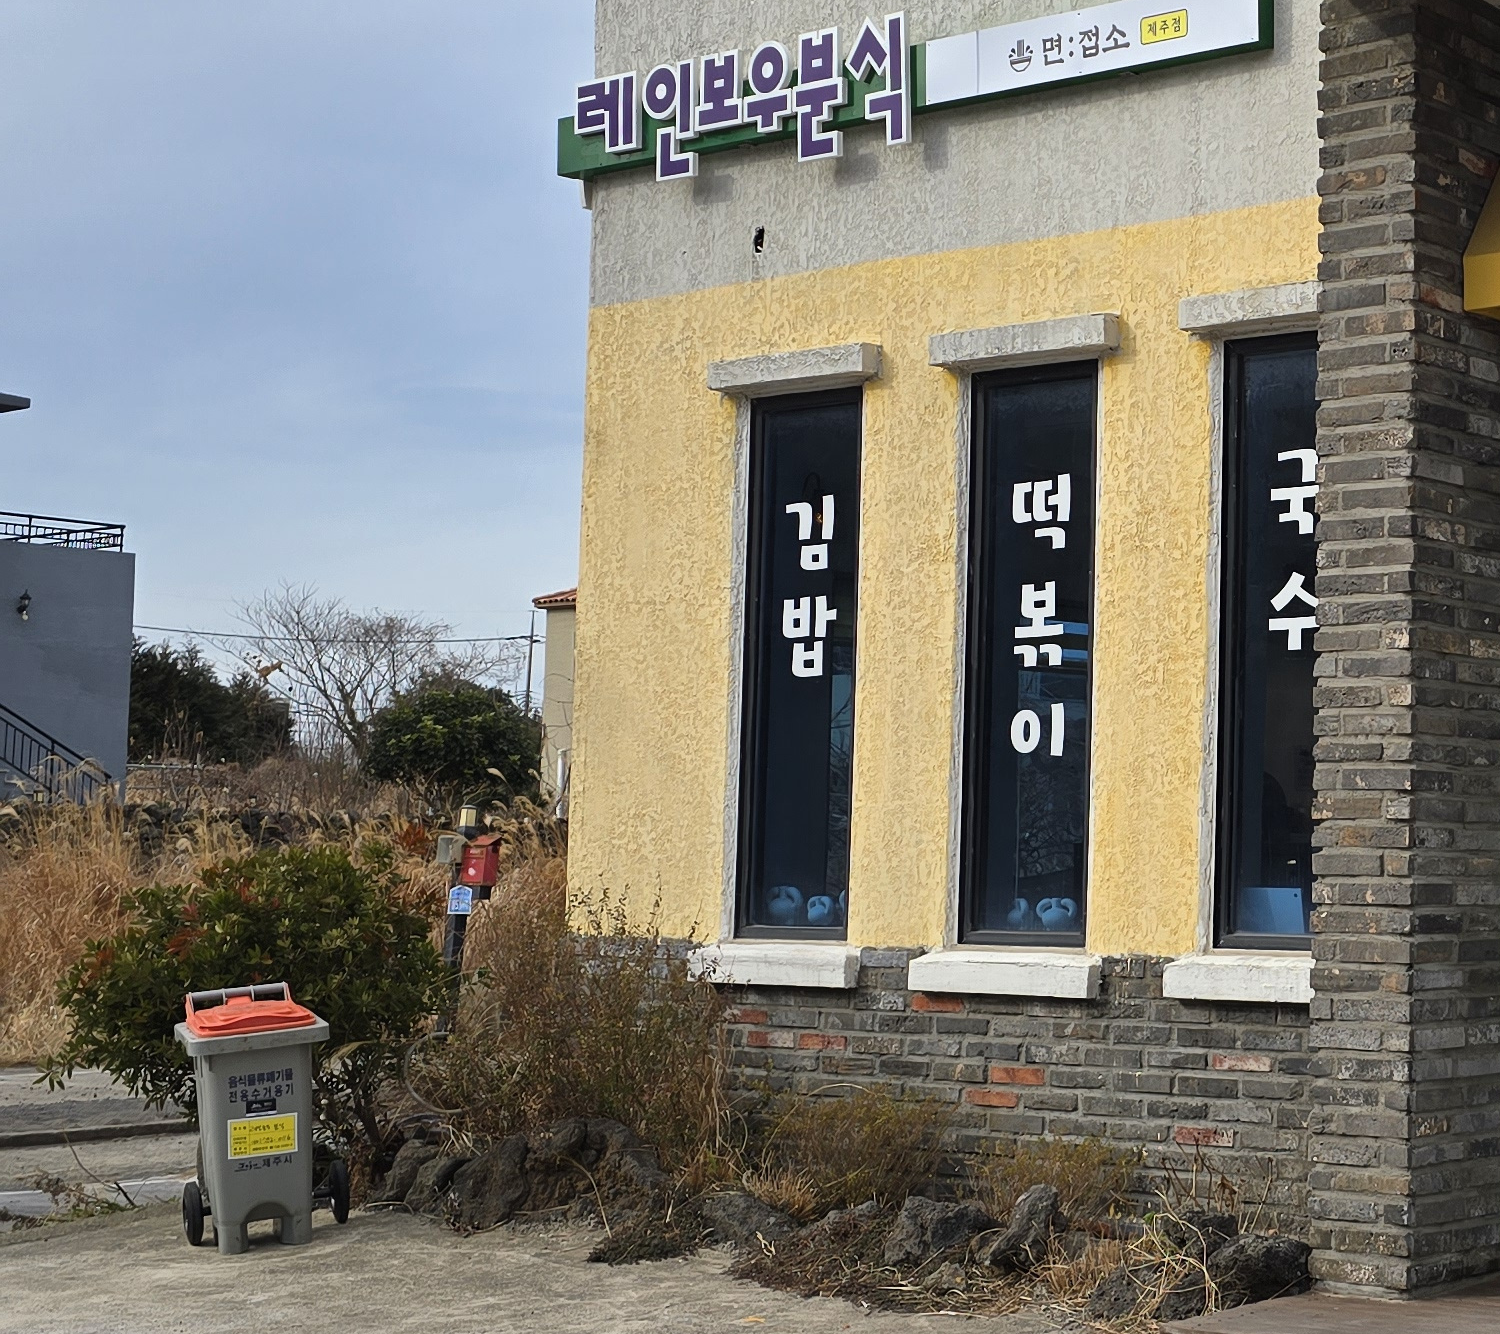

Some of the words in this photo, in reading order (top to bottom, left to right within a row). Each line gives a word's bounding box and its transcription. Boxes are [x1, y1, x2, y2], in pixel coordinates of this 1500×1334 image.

[574, 10, 911, 182] 레인보우분식
[1042, 24, 1130, 66] 면:접소
[1148, 16, 1181, 36] 제주점
[782, 495, 837, 677] 김밥
[1010, 474, 1071, 757] 떡볶이
[1269, 448, 1320, 650] 국수
